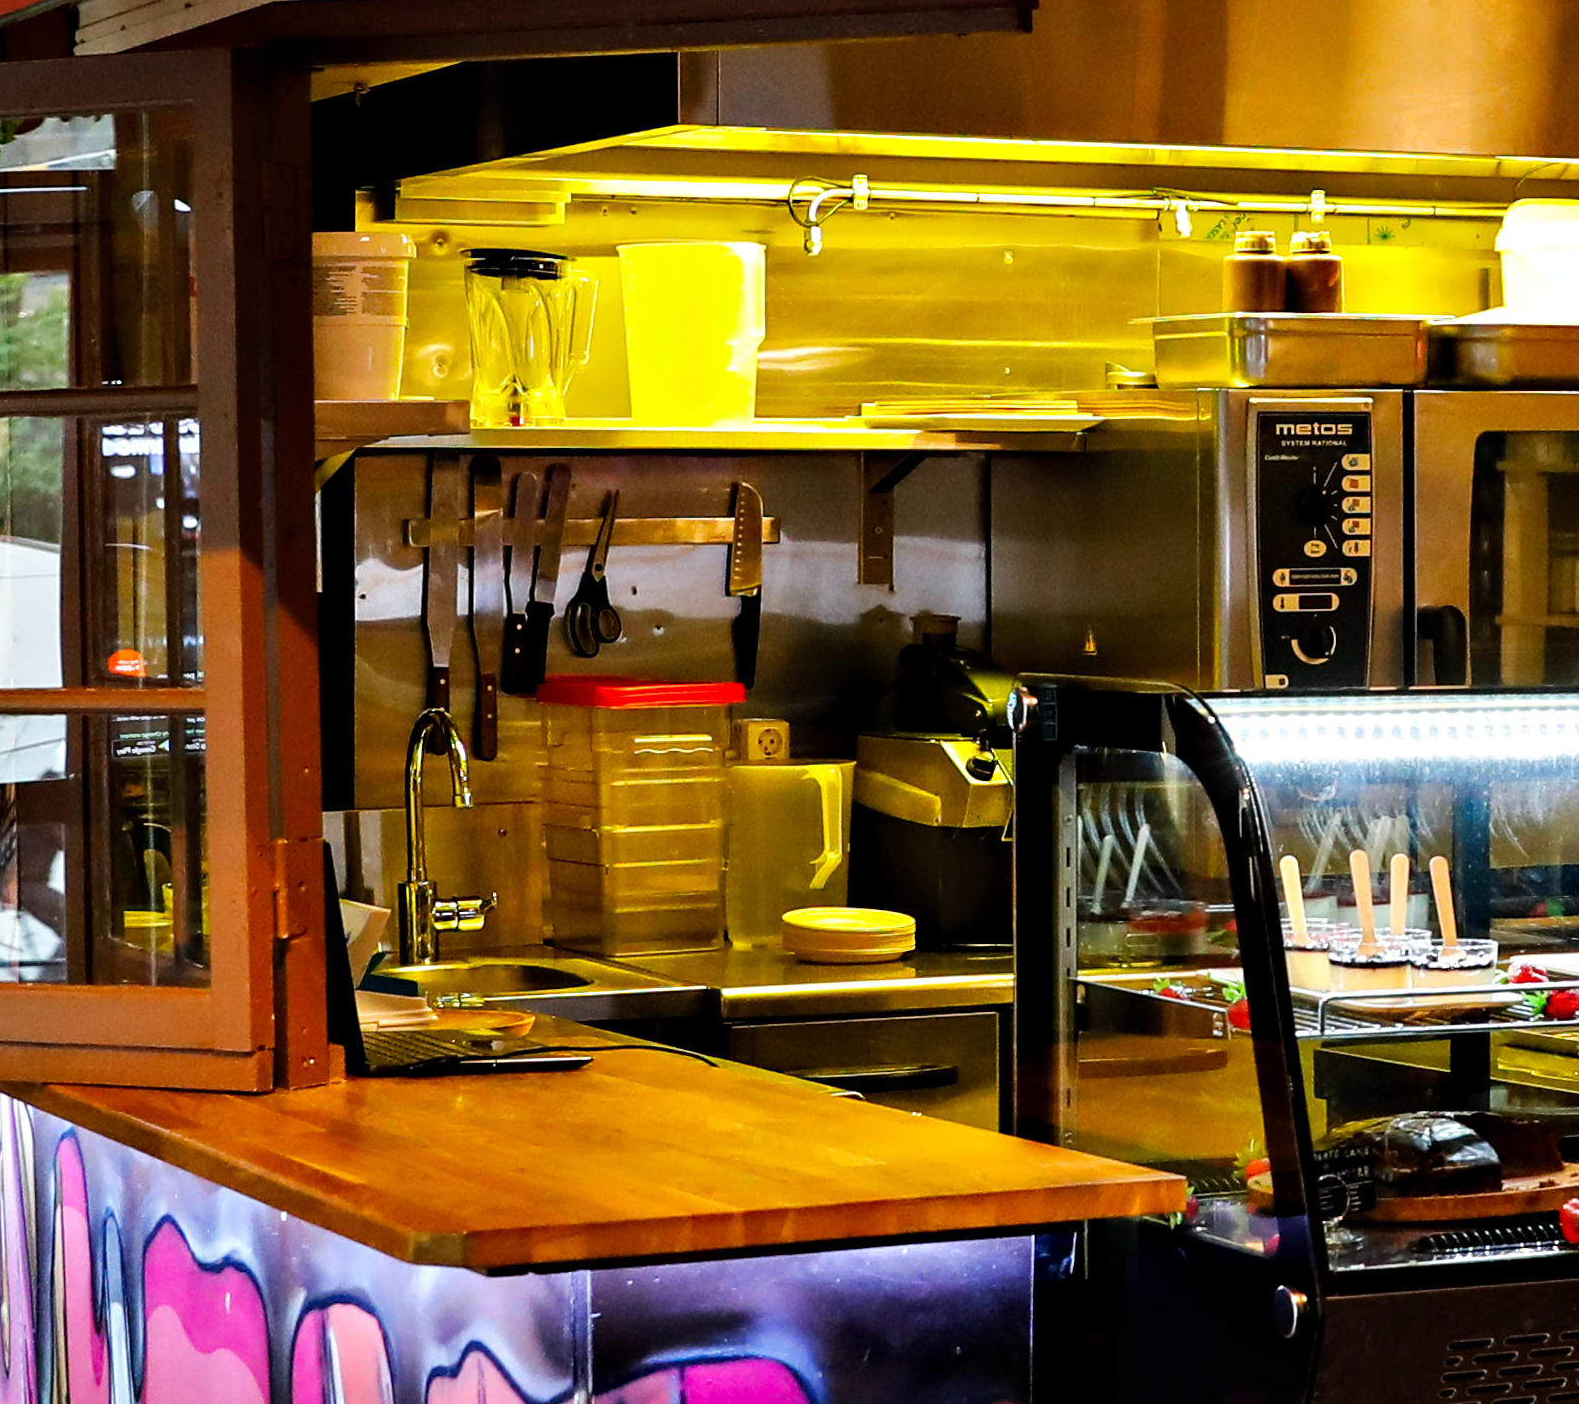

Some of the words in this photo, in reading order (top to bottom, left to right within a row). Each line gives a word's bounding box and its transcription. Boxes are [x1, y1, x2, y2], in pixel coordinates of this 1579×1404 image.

[1275, 422, 1353, 436] metos
[1281, 439, 1310, 447] SYSTEM
[1311, 439, 1348, 447] RATIONAL
